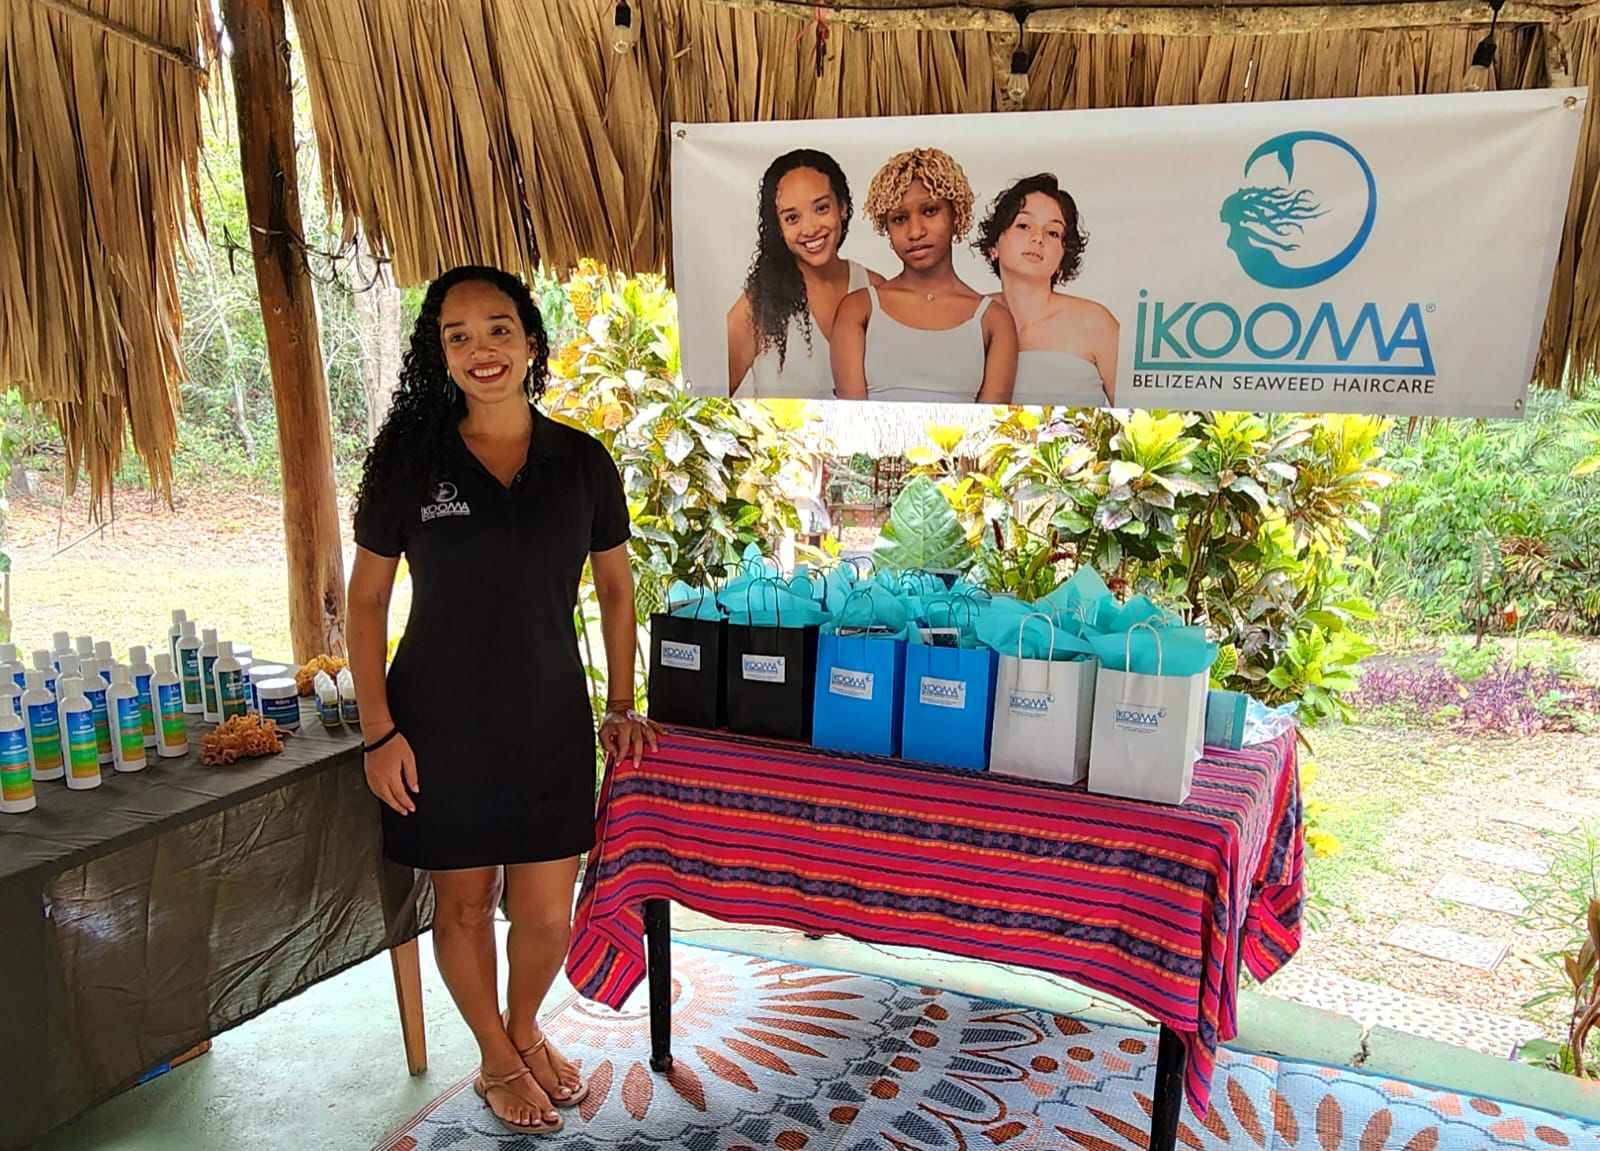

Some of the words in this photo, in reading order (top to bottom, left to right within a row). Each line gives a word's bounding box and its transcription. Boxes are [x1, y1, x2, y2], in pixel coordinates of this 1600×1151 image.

[1132, 374, 1223, 390] BELIZEAN
[1232, 376, 1325, 392] SEAWEED
[1333, 378, 1436, 394] HAIRCARE
